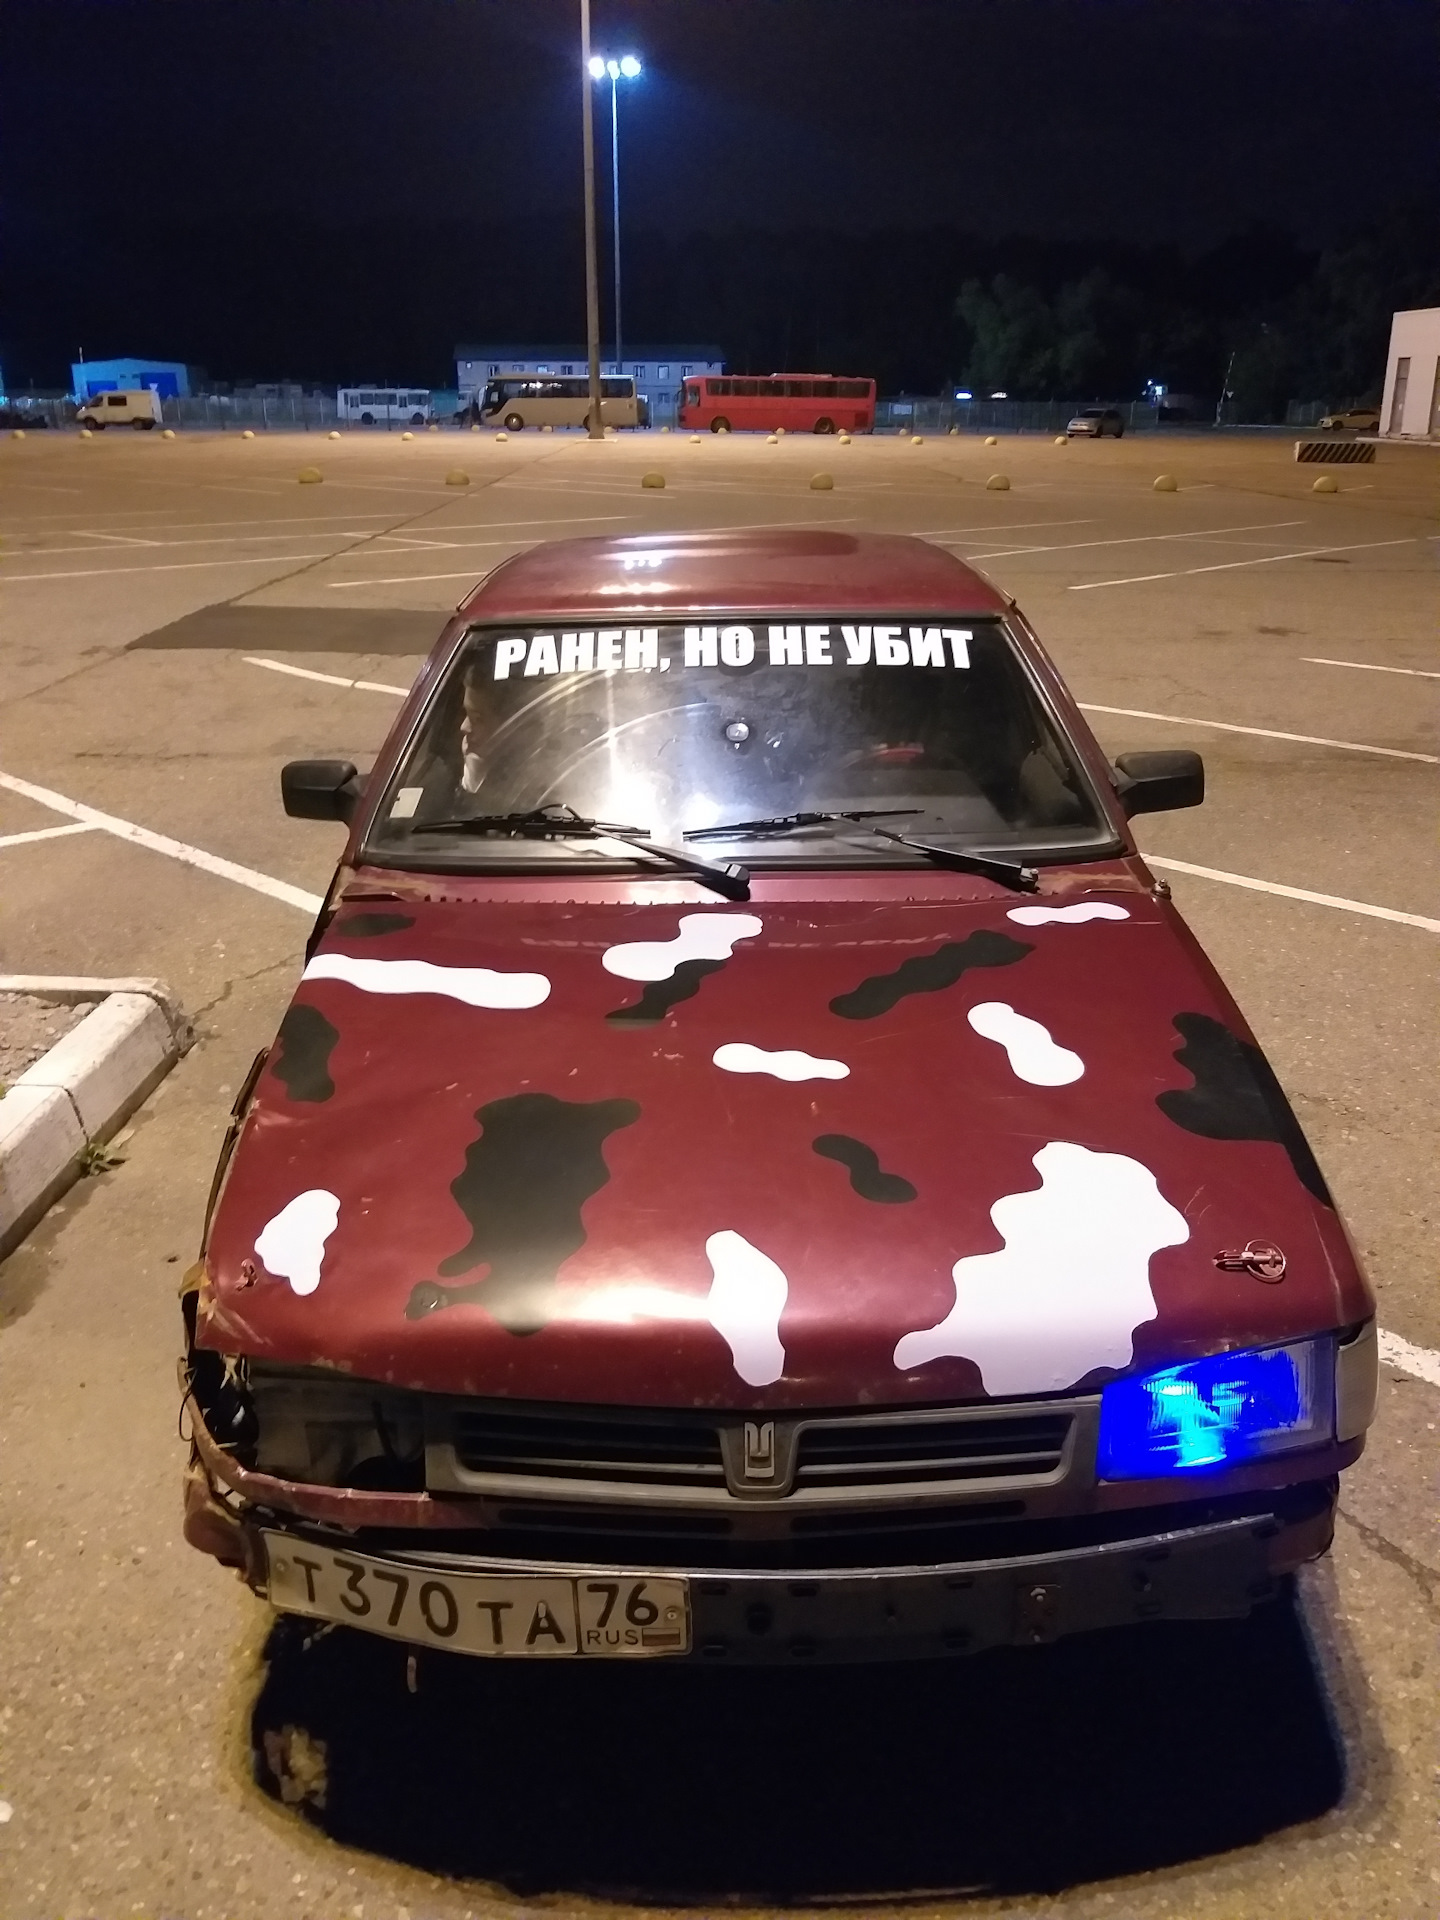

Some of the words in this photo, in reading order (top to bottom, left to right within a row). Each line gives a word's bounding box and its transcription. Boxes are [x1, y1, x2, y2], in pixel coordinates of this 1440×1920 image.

[493, 628, 672, 680] РАНЕН,
[683, 626, 756, 667] НО
[768, 625, 834, 666] НЕ
[840, 626, 974, 669] УБИТ
[587, 1582, 659, 1628] 76
[586, 1629, 639, 1646] RUS
